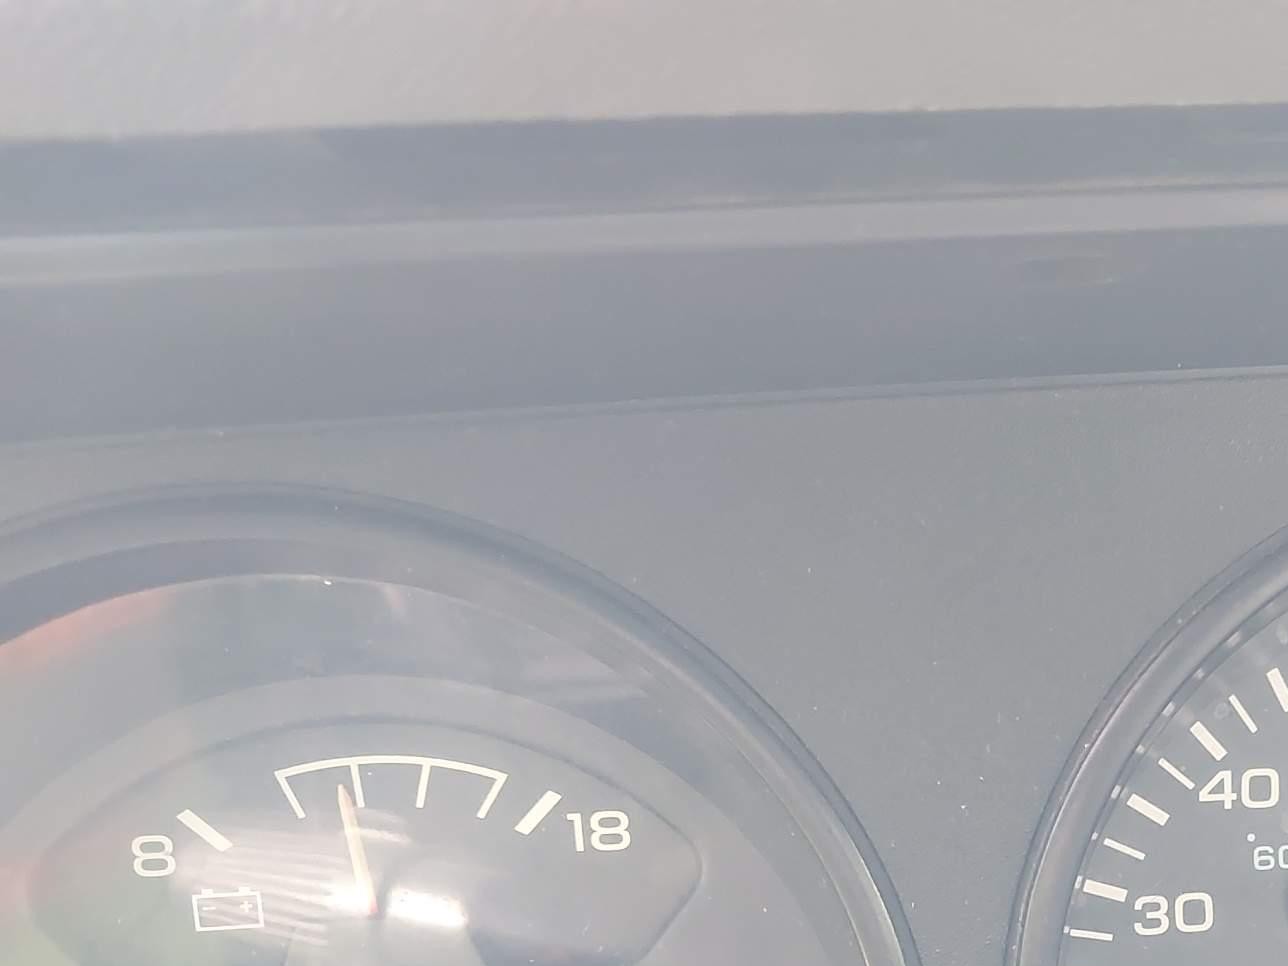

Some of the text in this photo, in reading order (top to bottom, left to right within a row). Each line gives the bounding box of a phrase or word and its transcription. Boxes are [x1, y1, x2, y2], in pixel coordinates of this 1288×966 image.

[1198, 768, 1280, 809] 40
[567, 810, 631, 852] 18
[131, 834, 176, 877] 8
[1133, 892, 1214, 936] 30
